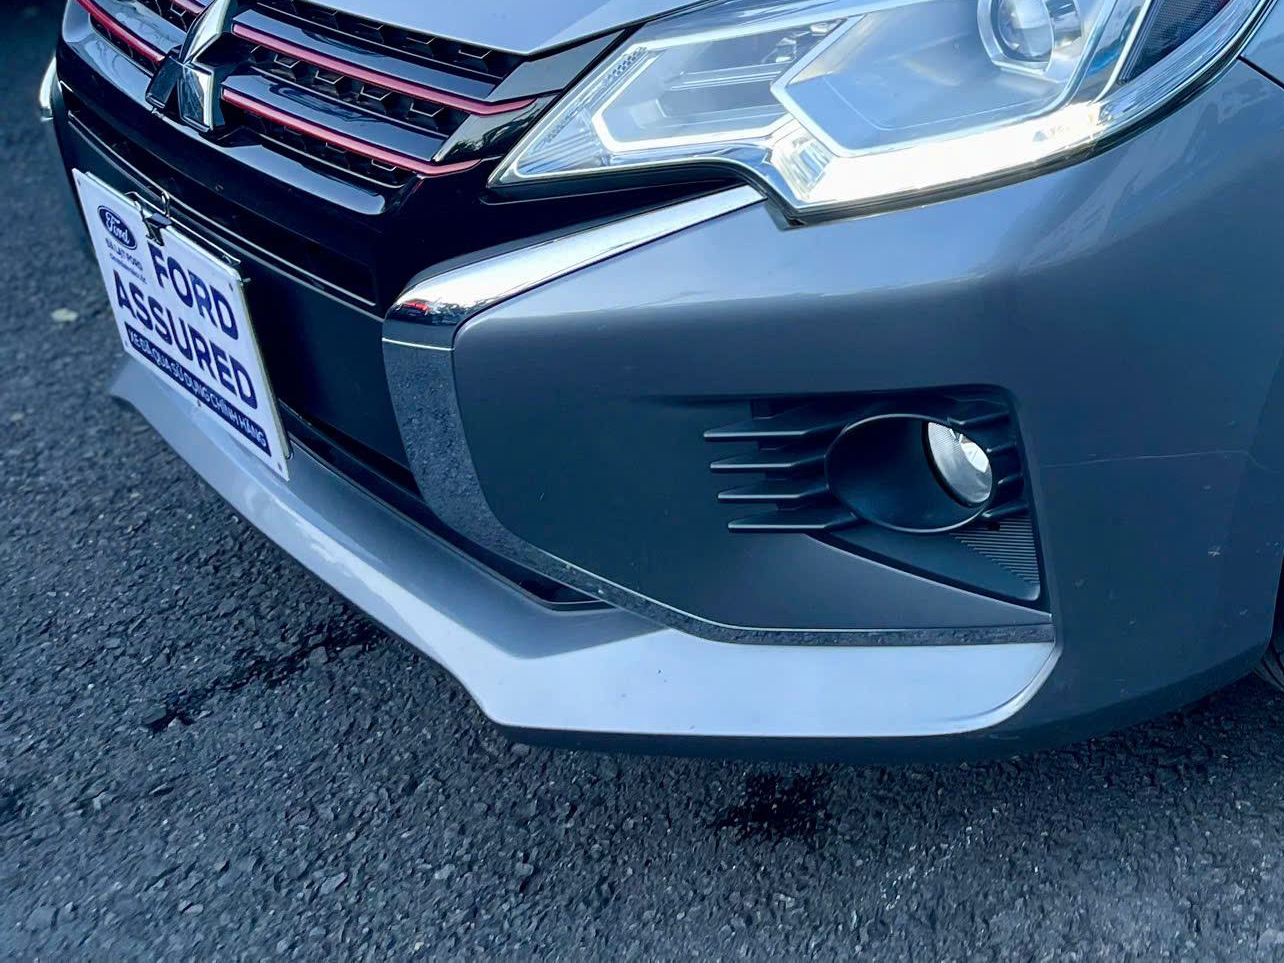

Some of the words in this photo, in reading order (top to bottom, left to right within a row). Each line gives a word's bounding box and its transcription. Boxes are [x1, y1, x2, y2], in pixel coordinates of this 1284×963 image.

[113, 268, 258, 409] ASSURED
[147, 240, 238, 340] FORD
[152, 348, 172, 373] QUA
